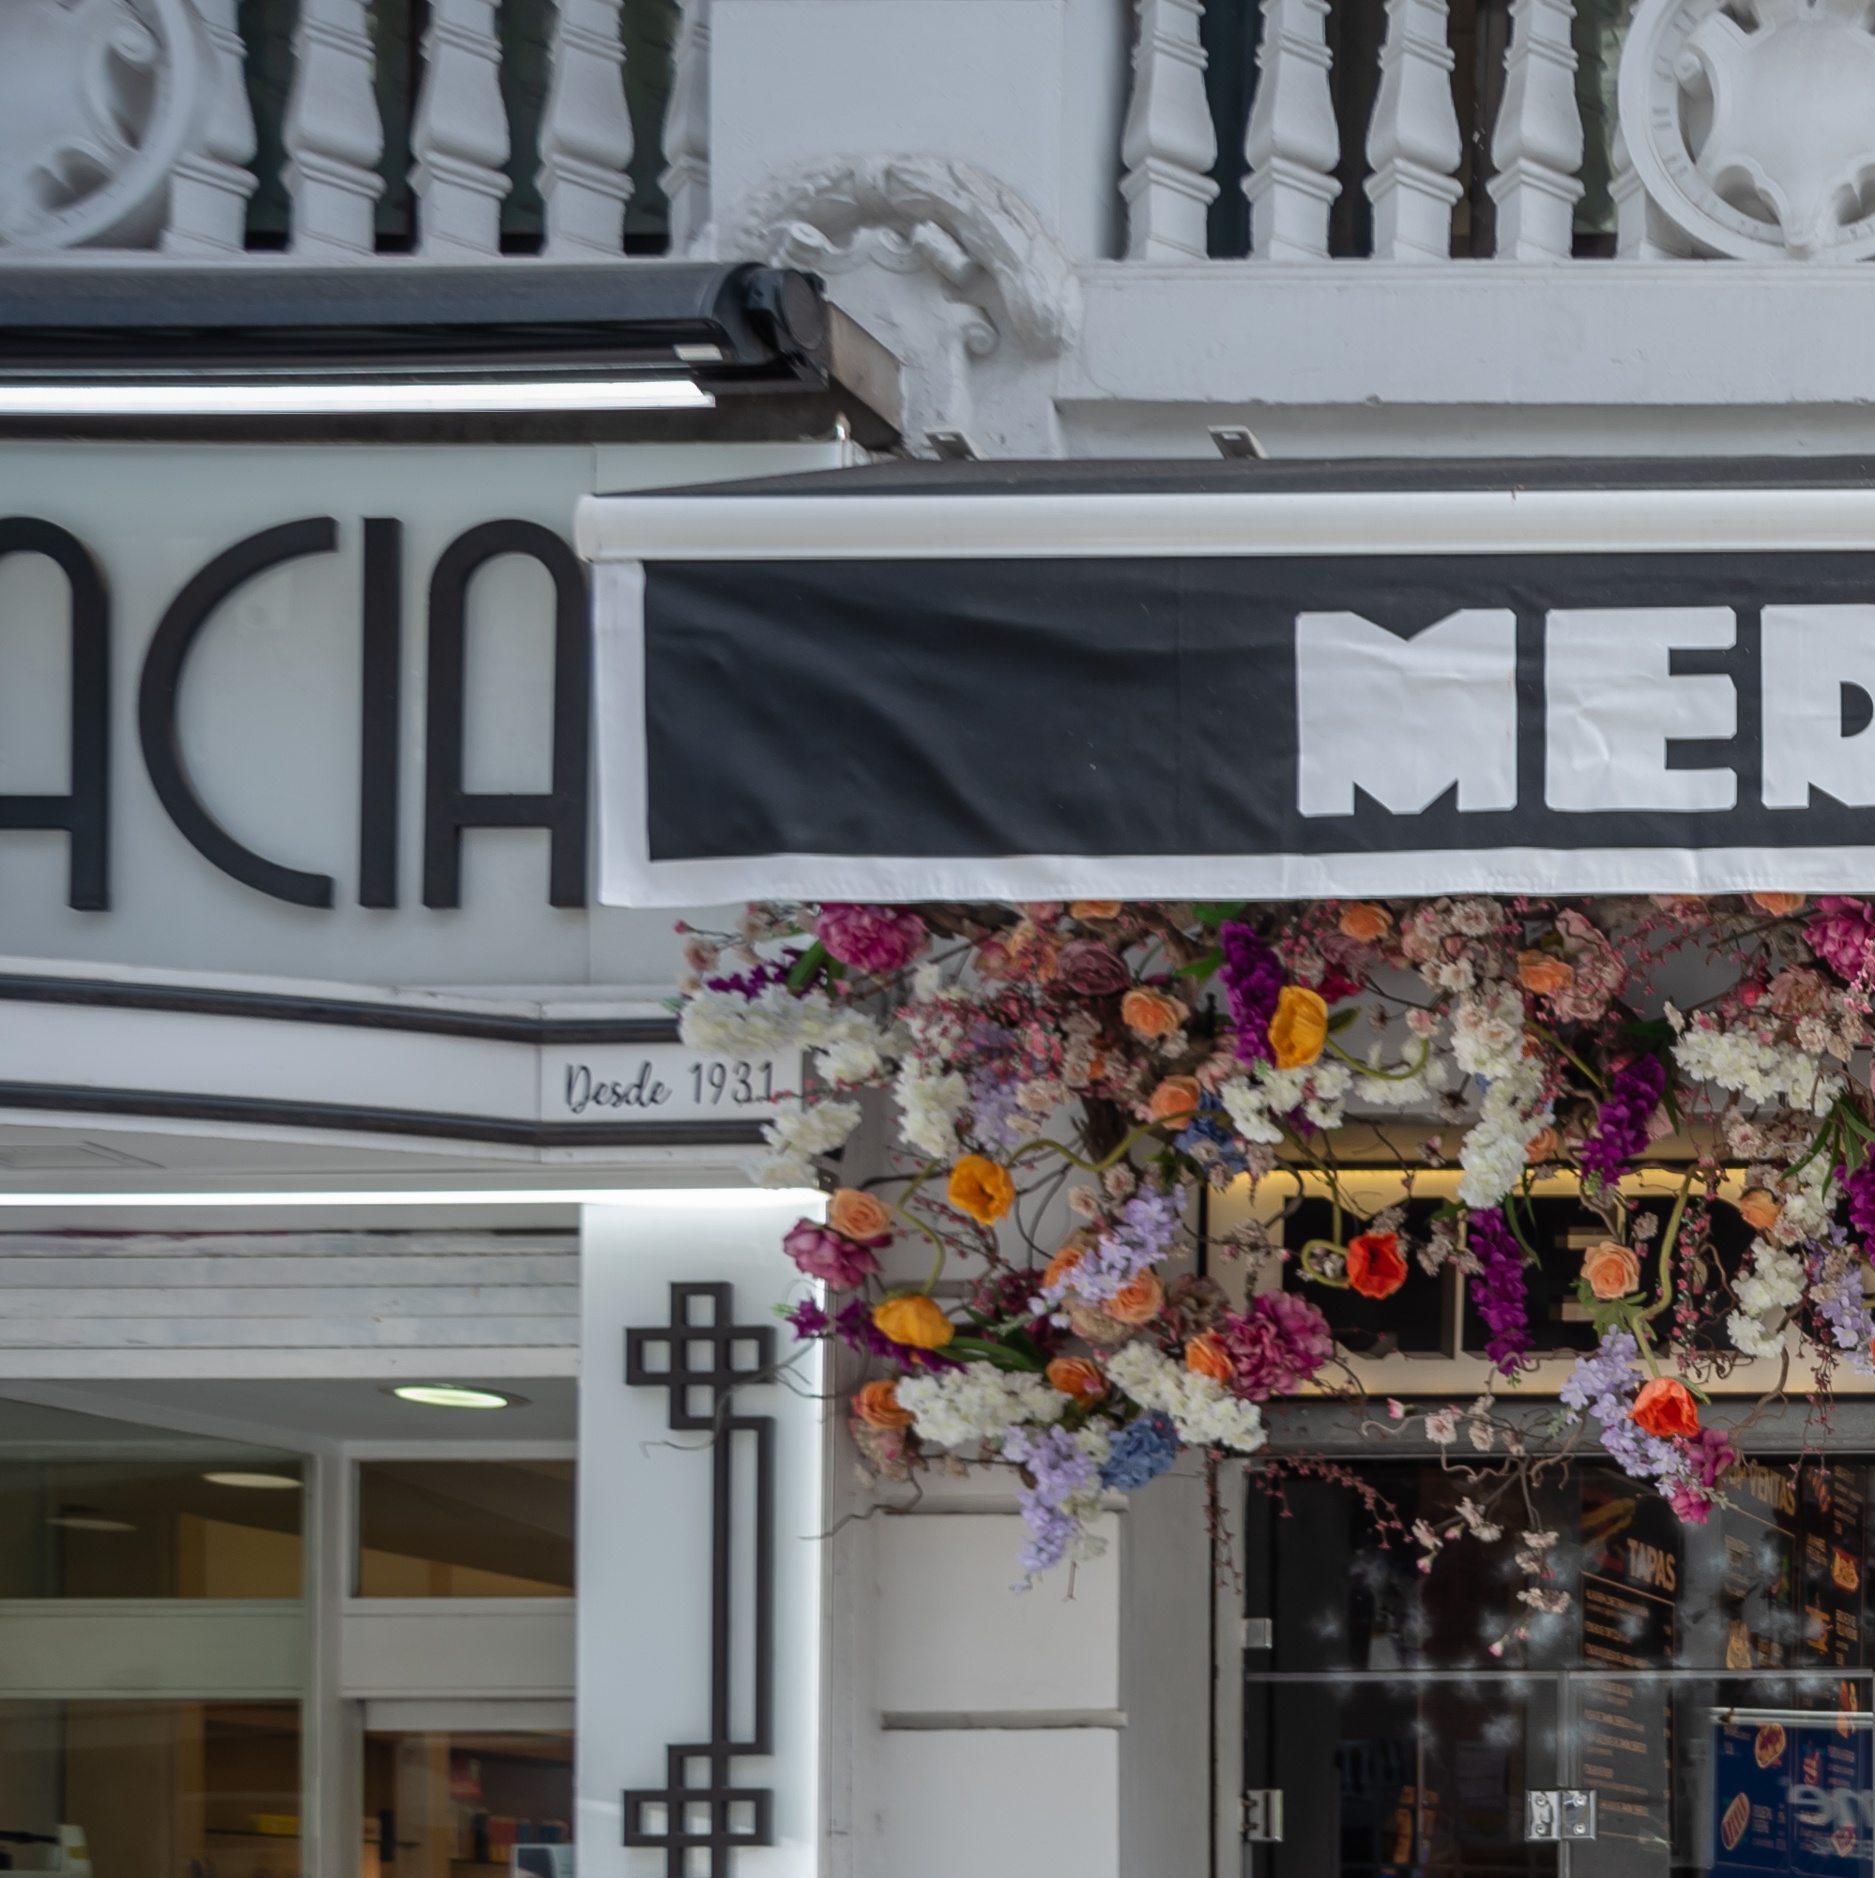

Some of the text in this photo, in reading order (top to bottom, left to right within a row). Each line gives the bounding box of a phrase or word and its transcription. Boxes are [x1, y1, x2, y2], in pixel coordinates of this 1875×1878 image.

[565, 1060, 776, 1113] Desde 1931
[1625, 1537, 1676, 1593] TAPAS
